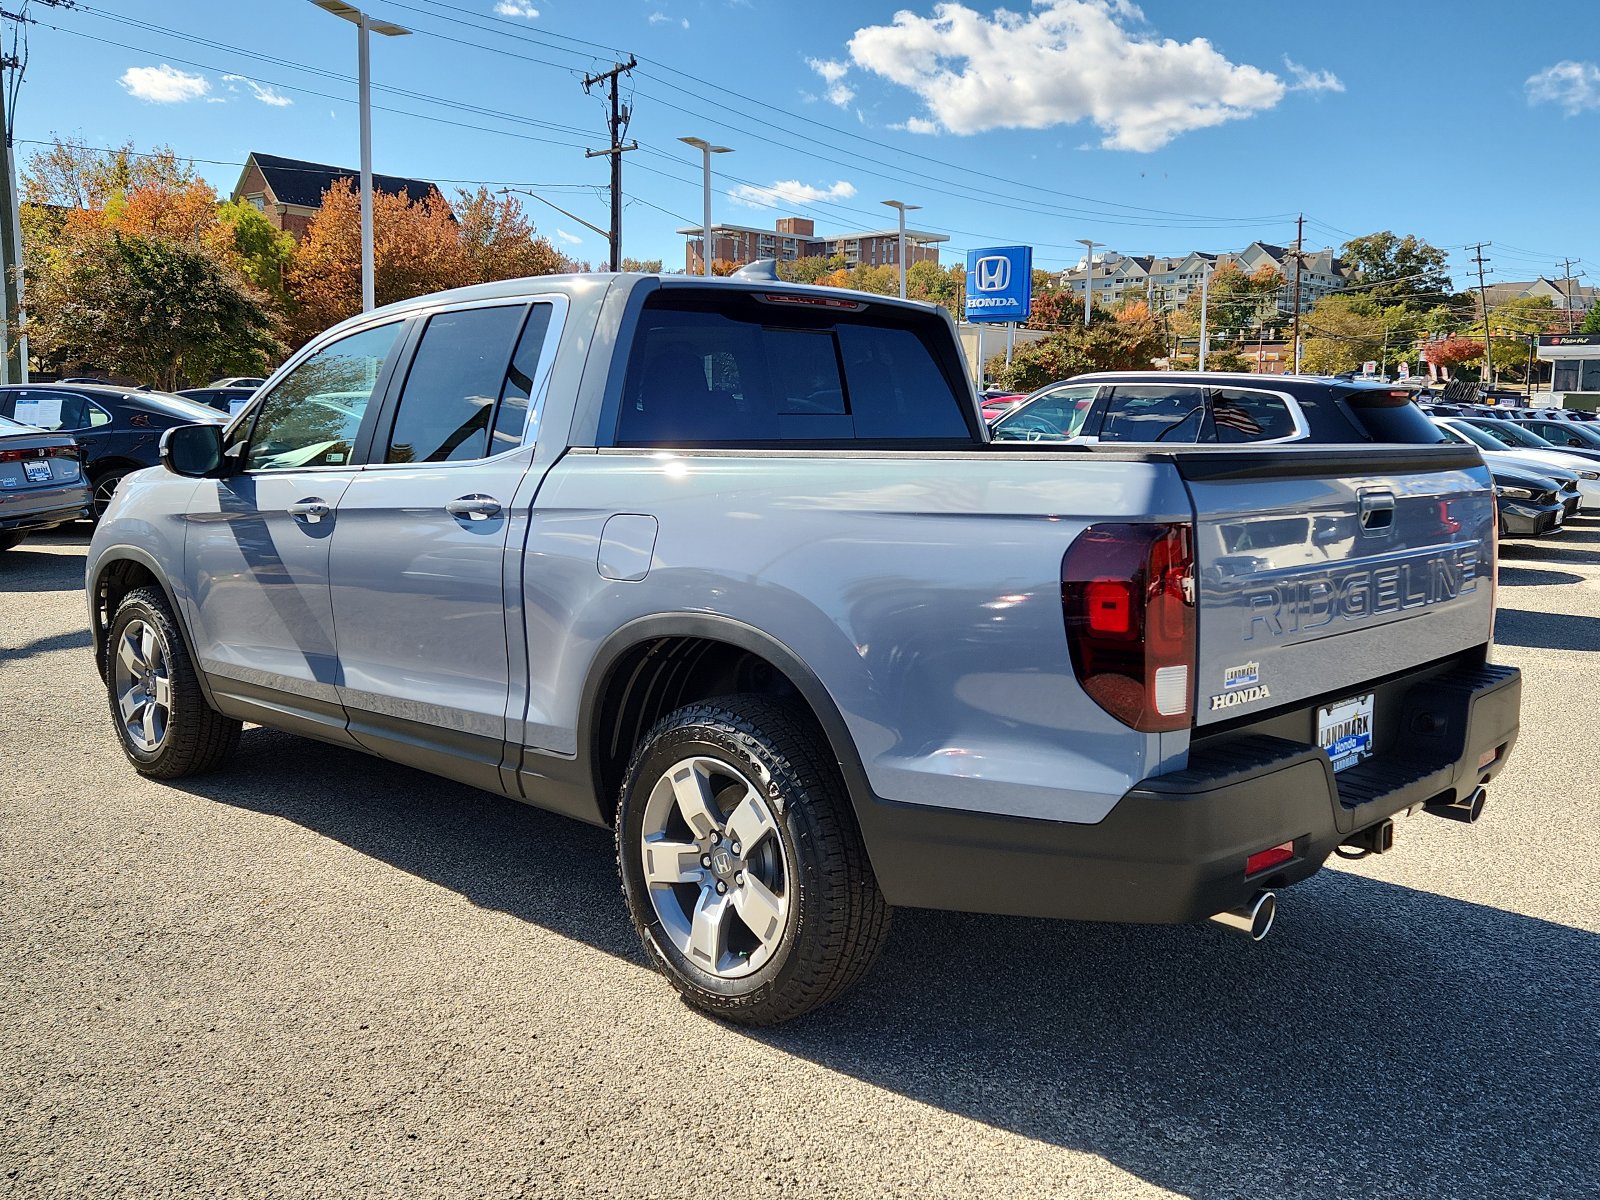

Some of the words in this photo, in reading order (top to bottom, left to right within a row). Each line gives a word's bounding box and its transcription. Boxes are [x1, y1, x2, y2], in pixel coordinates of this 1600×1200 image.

[967, 298, 1019, 308] HONDA
[1241, 551, 1478, 641] RIDGELINE
[1210, 685, 1270, 710] HONDA
[1320, 715, 1369, 747] LANDMARK
[1335, 738, 1357, 754] Honda
